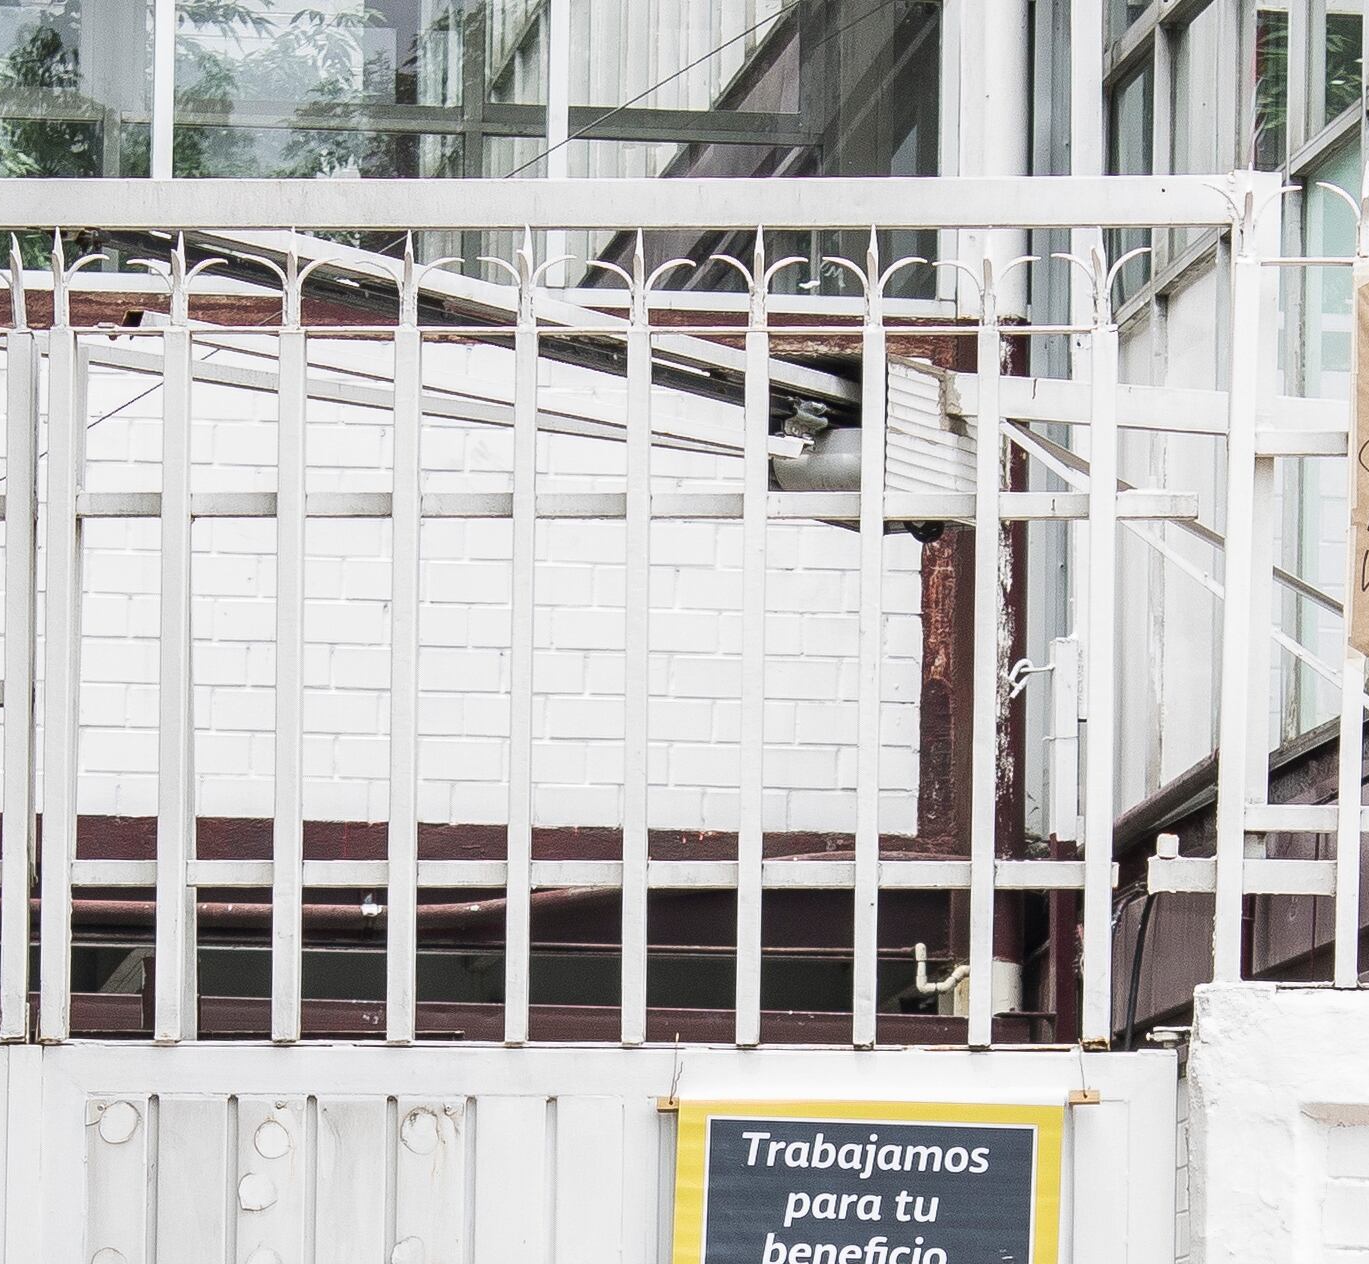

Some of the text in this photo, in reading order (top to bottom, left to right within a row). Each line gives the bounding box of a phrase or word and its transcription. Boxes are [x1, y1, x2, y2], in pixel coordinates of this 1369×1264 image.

[741, 1131, 991, 1180] Trabajamos
[783, 1190, 940, 1228] para tu
